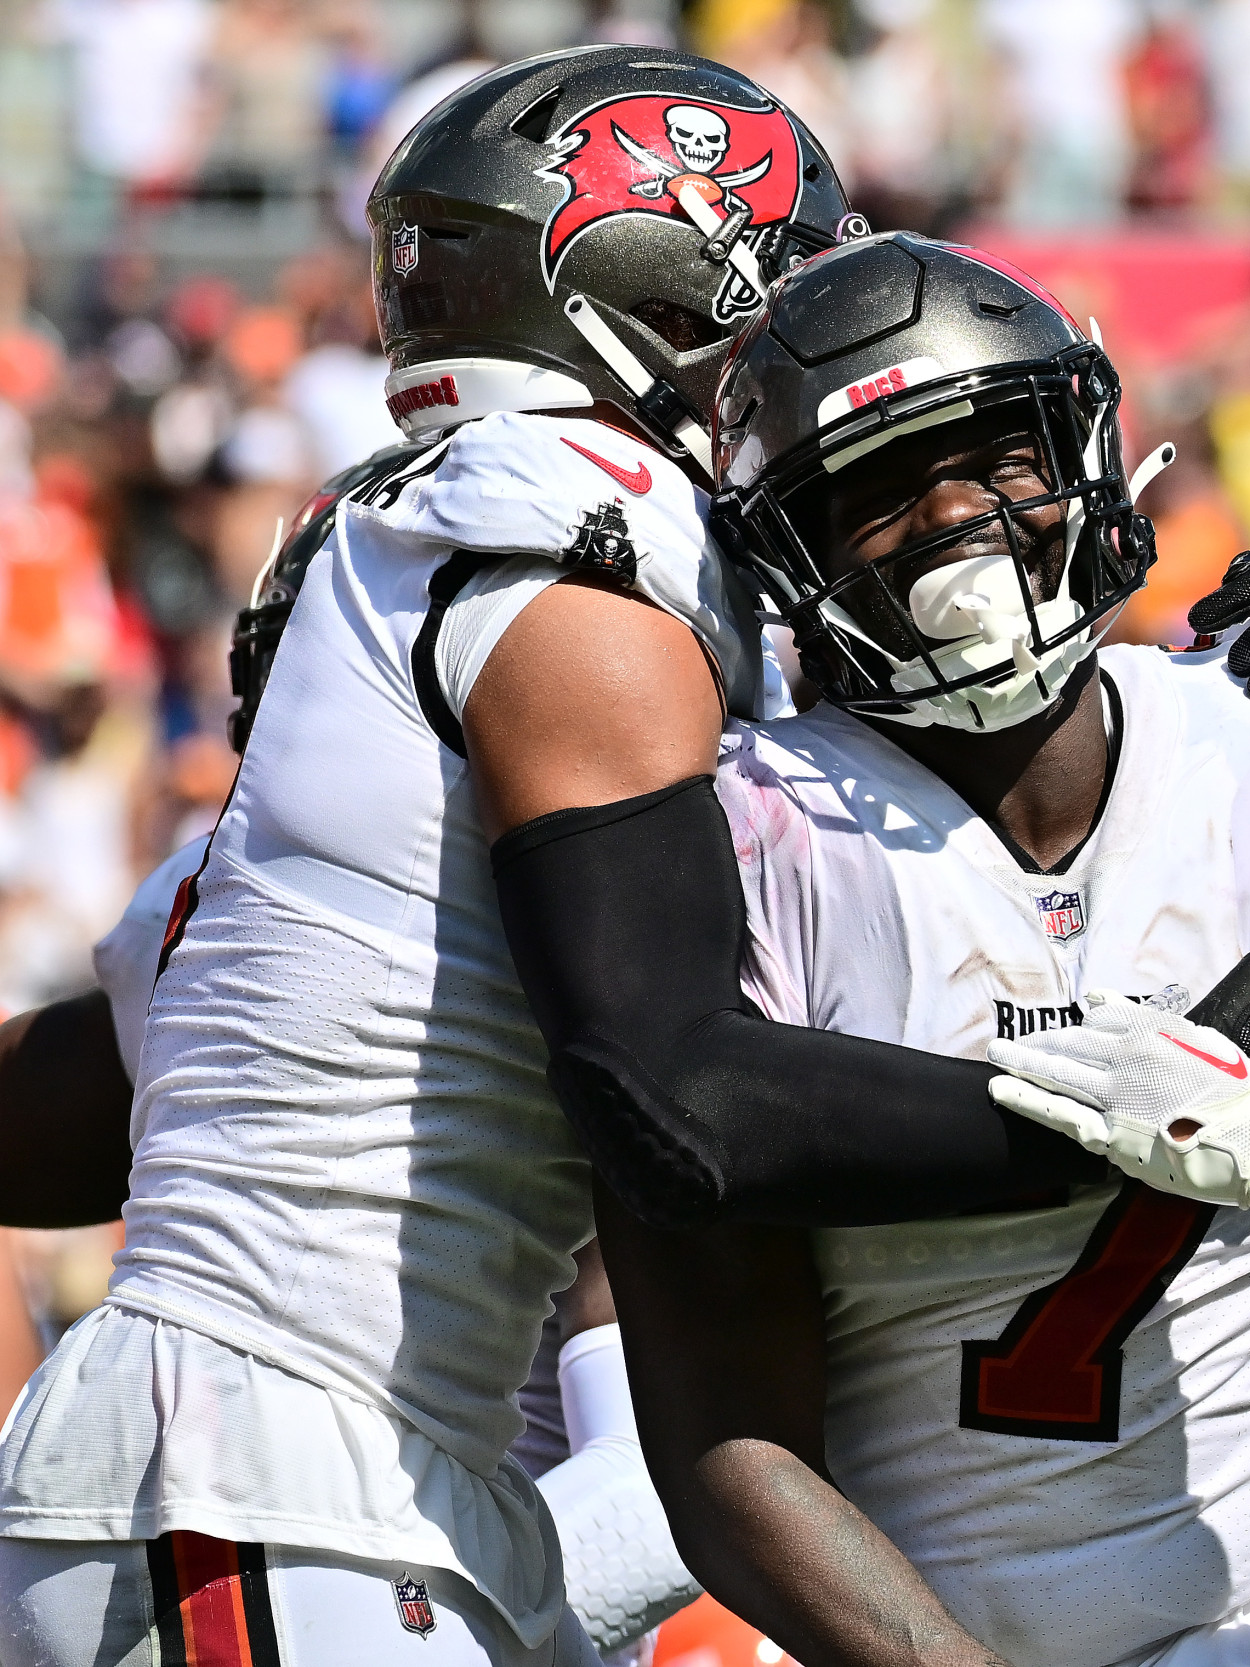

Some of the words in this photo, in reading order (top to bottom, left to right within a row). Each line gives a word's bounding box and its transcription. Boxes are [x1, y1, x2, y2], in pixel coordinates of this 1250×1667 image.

[395, 245, 415, 268] NFL
[1042, 909, 1080, 935] NFL
[403, 1602, 432, 1628] NFL
